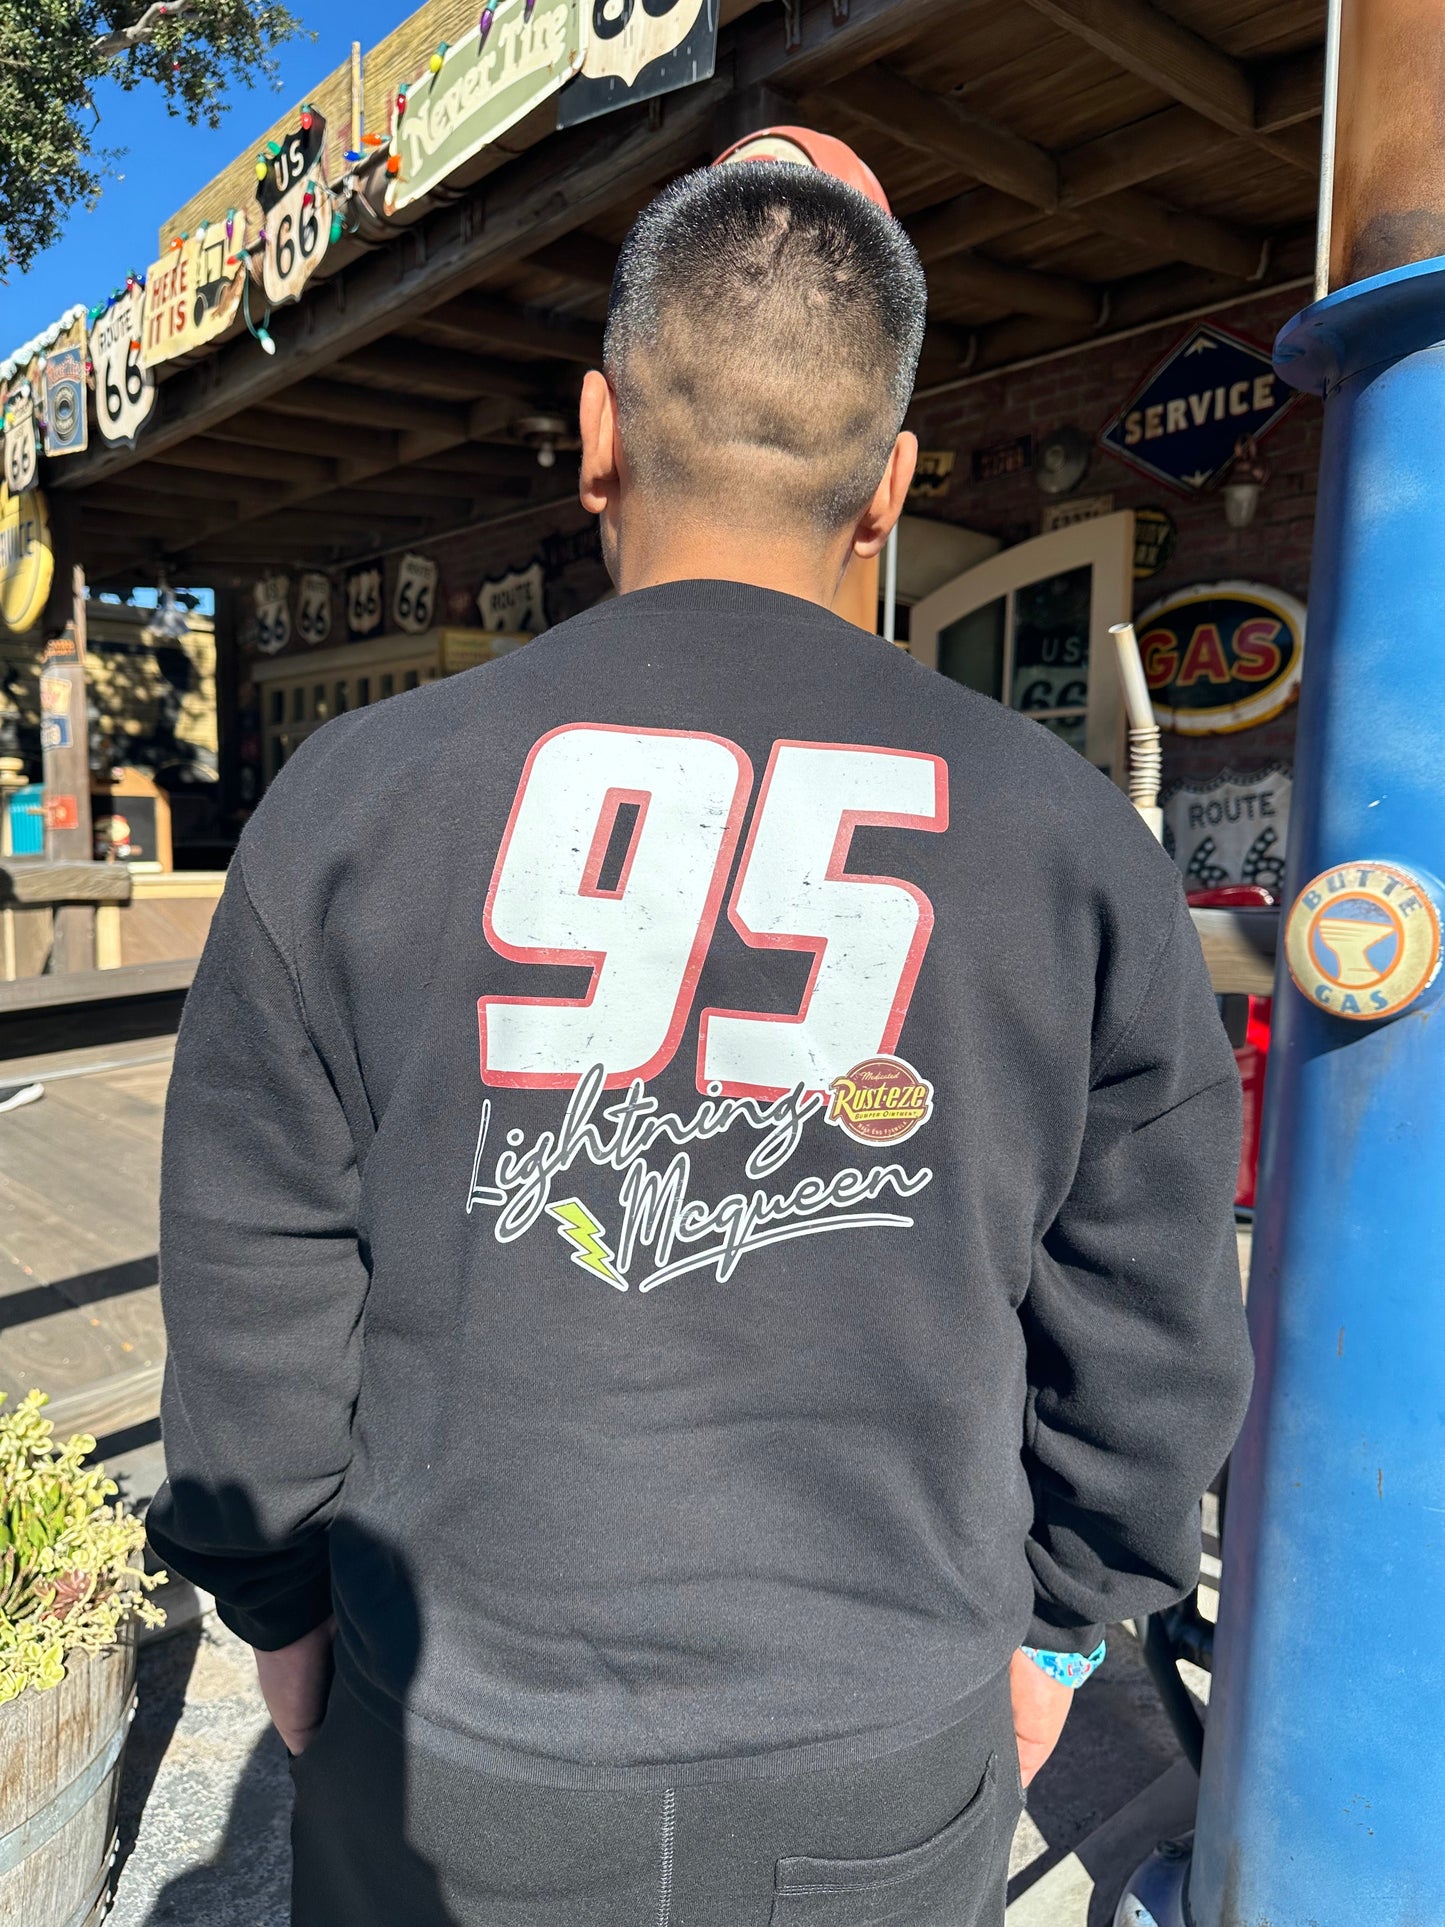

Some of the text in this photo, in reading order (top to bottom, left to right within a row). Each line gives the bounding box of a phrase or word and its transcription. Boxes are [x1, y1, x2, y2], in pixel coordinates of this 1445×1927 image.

[402, 50, 497, 177] Never
[498, 3, 567, 68] Tire
[275, 138, 304, 193] US
[276, 203, 319, 279] 66
[153, 260, 189, 311] HERE
[98, 308, 133, 355] ROUTE
[147, 299, 187, 349] IT IS
[106, 343, 142, 422] 66
[1125, 372, 1276, 444] SERVICE
[12, 434, 30, 482] 66
[302, 599, 325, 636] 66
[356, 586, 376, 618] 66
[400, 582, 428, 625] 66
[491, 580, 533, 610] ROUTE
[257, 605, 285, 645] 66
[1041, 635, 1081, 664] US
[1139, 617, 1282, 689] GAS
[1189, 791, 1276, 830] ROUTE
[1185, 825, 1285, 886] 66
[477, 721, 951, 1104] 95
[1301, 869, 1423, 918] BUTTE
[1314, 983, 1389, 1015] GAS
[860, 1070, 900, 1082] Medicated
[466, 1063, 828, 1243] Lightning
